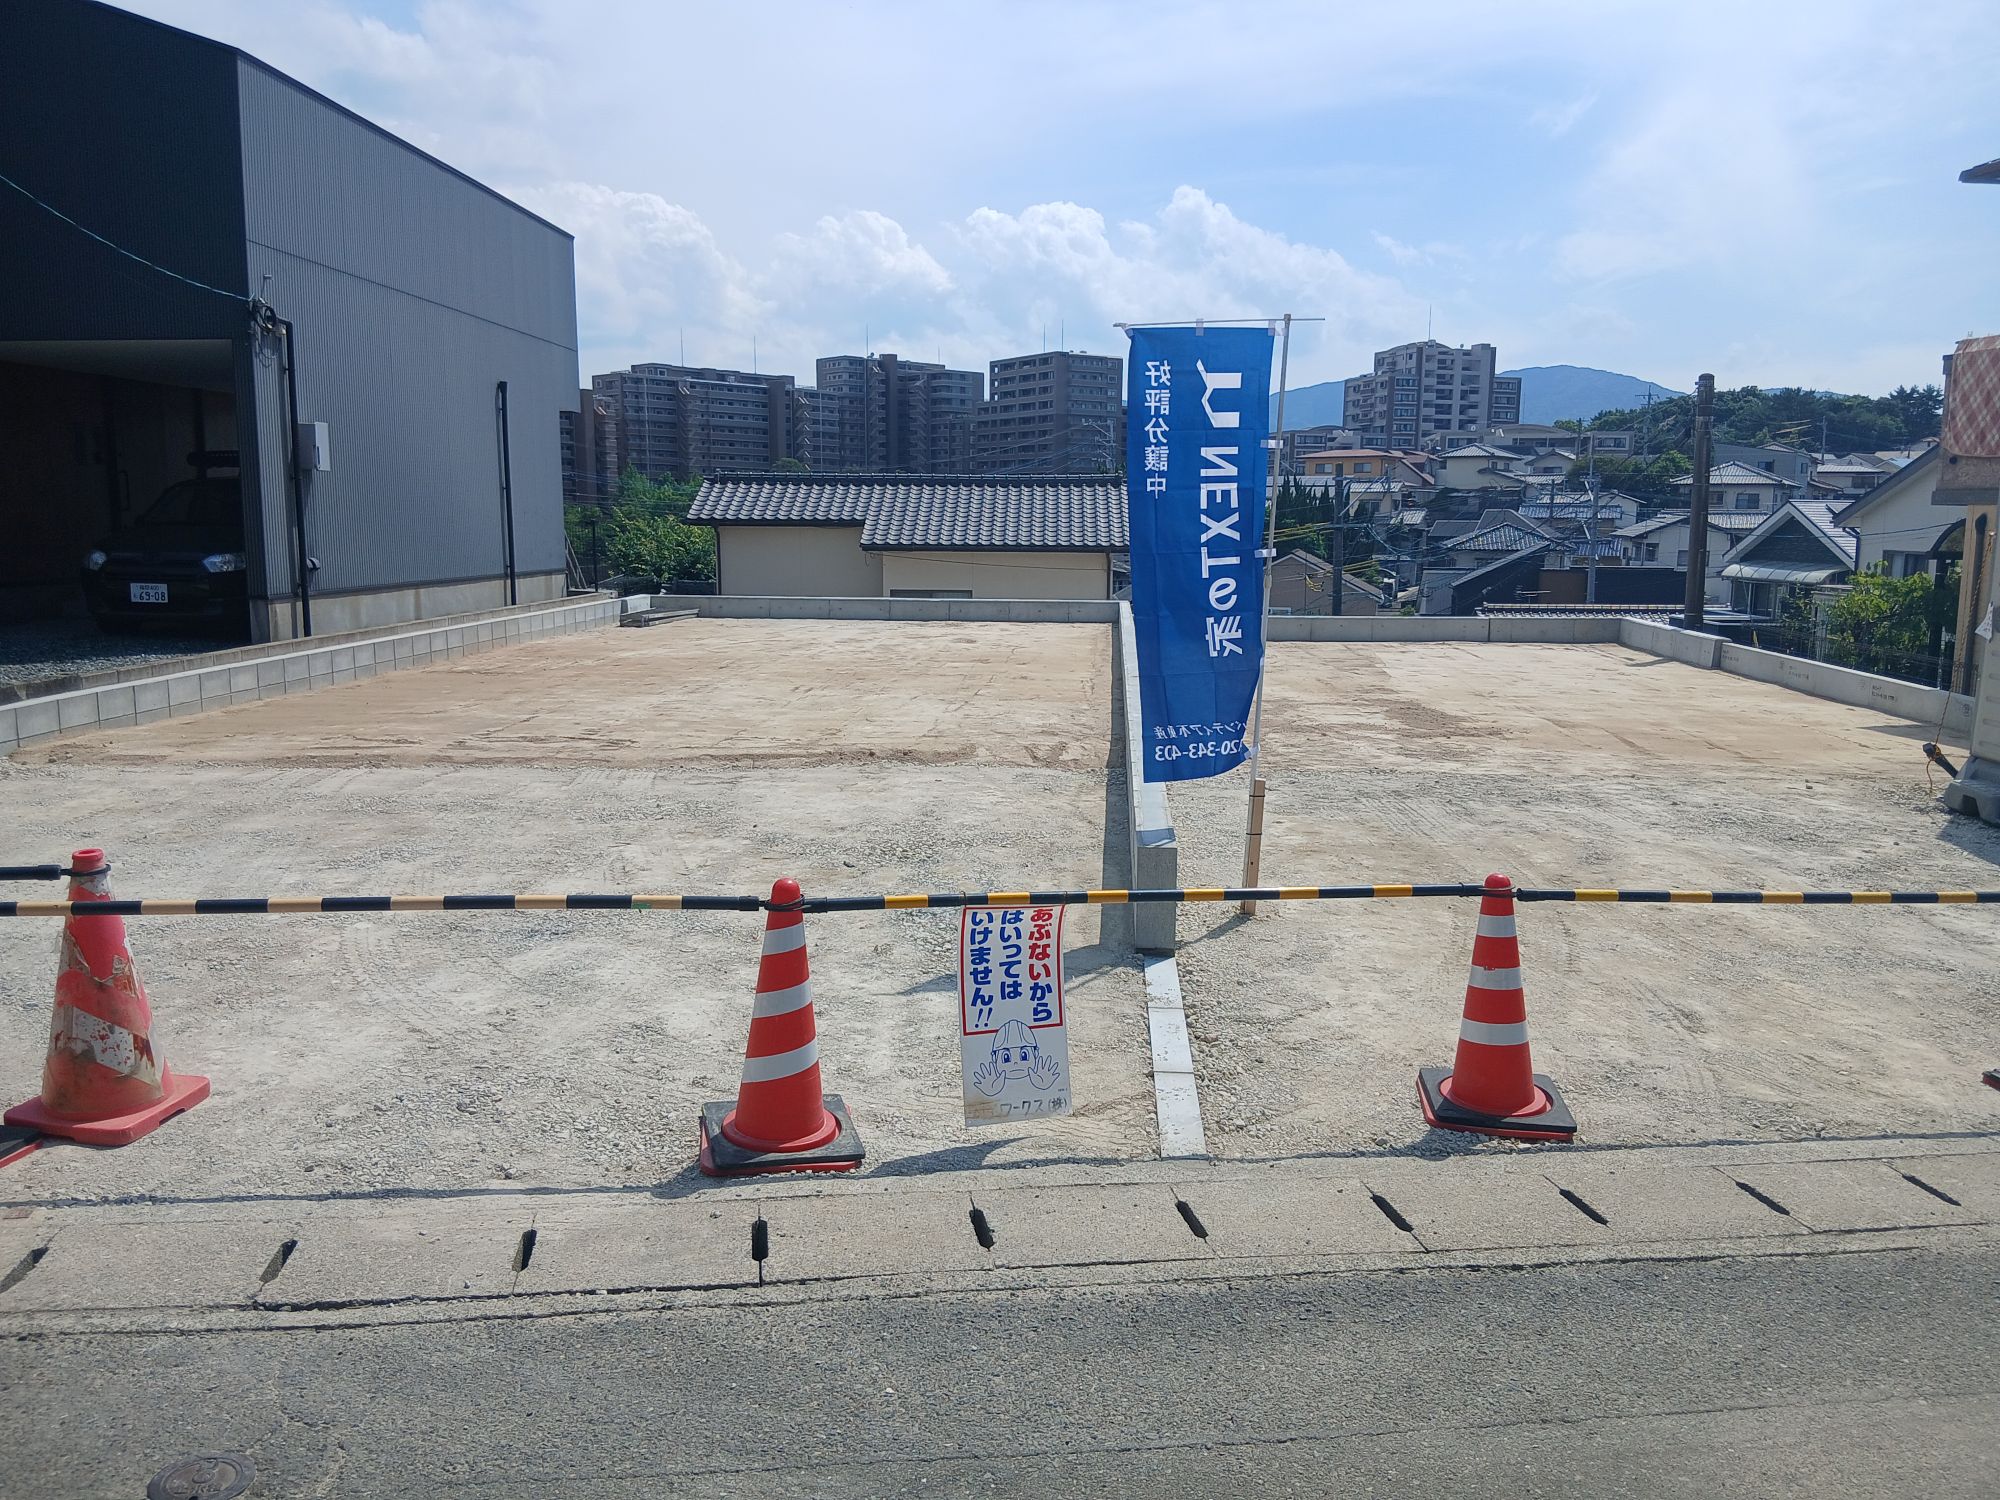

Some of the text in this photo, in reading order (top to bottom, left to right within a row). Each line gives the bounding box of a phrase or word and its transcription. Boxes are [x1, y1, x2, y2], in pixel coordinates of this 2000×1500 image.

[999, 910, 1025, 1000] はいっては
[1028, 908, 1054, 1023] あぶないから
